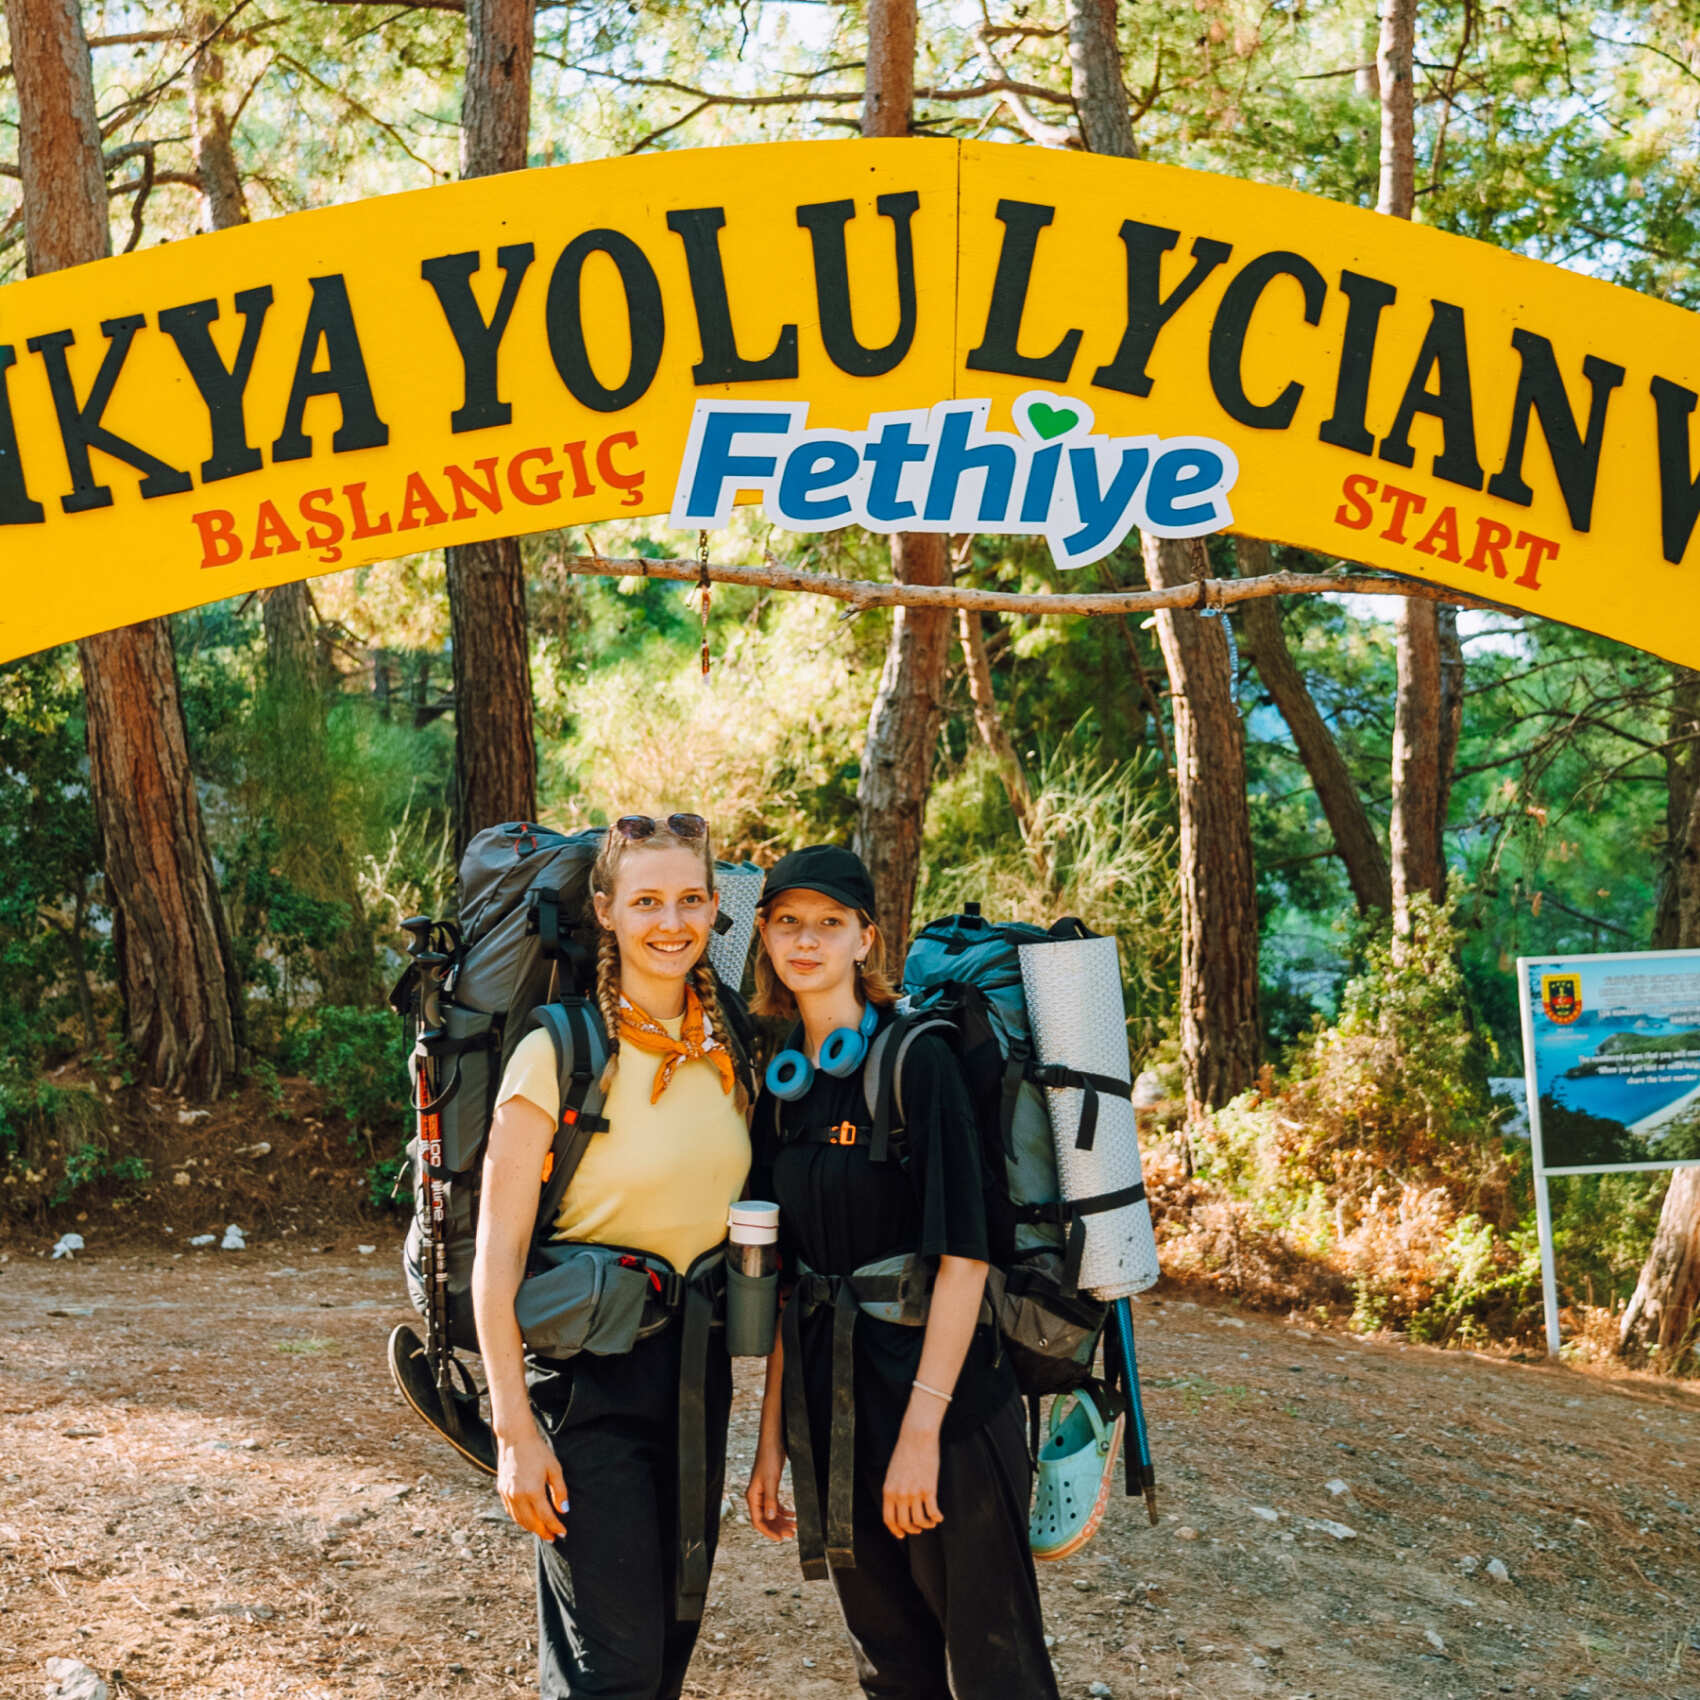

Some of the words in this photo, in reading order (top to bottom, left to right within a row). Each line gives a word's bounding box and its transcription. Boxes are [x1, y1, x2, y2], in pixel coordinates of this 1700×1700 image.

[422, 191, 919, 434] YOLU
[967, 200, 1625, 532] LYCIAN
[192, 431, 645, 568] BAŞLANGIÇ
[687, 402, 1223, 556] Fethiye
[1335, 475, 1560, 590] START
